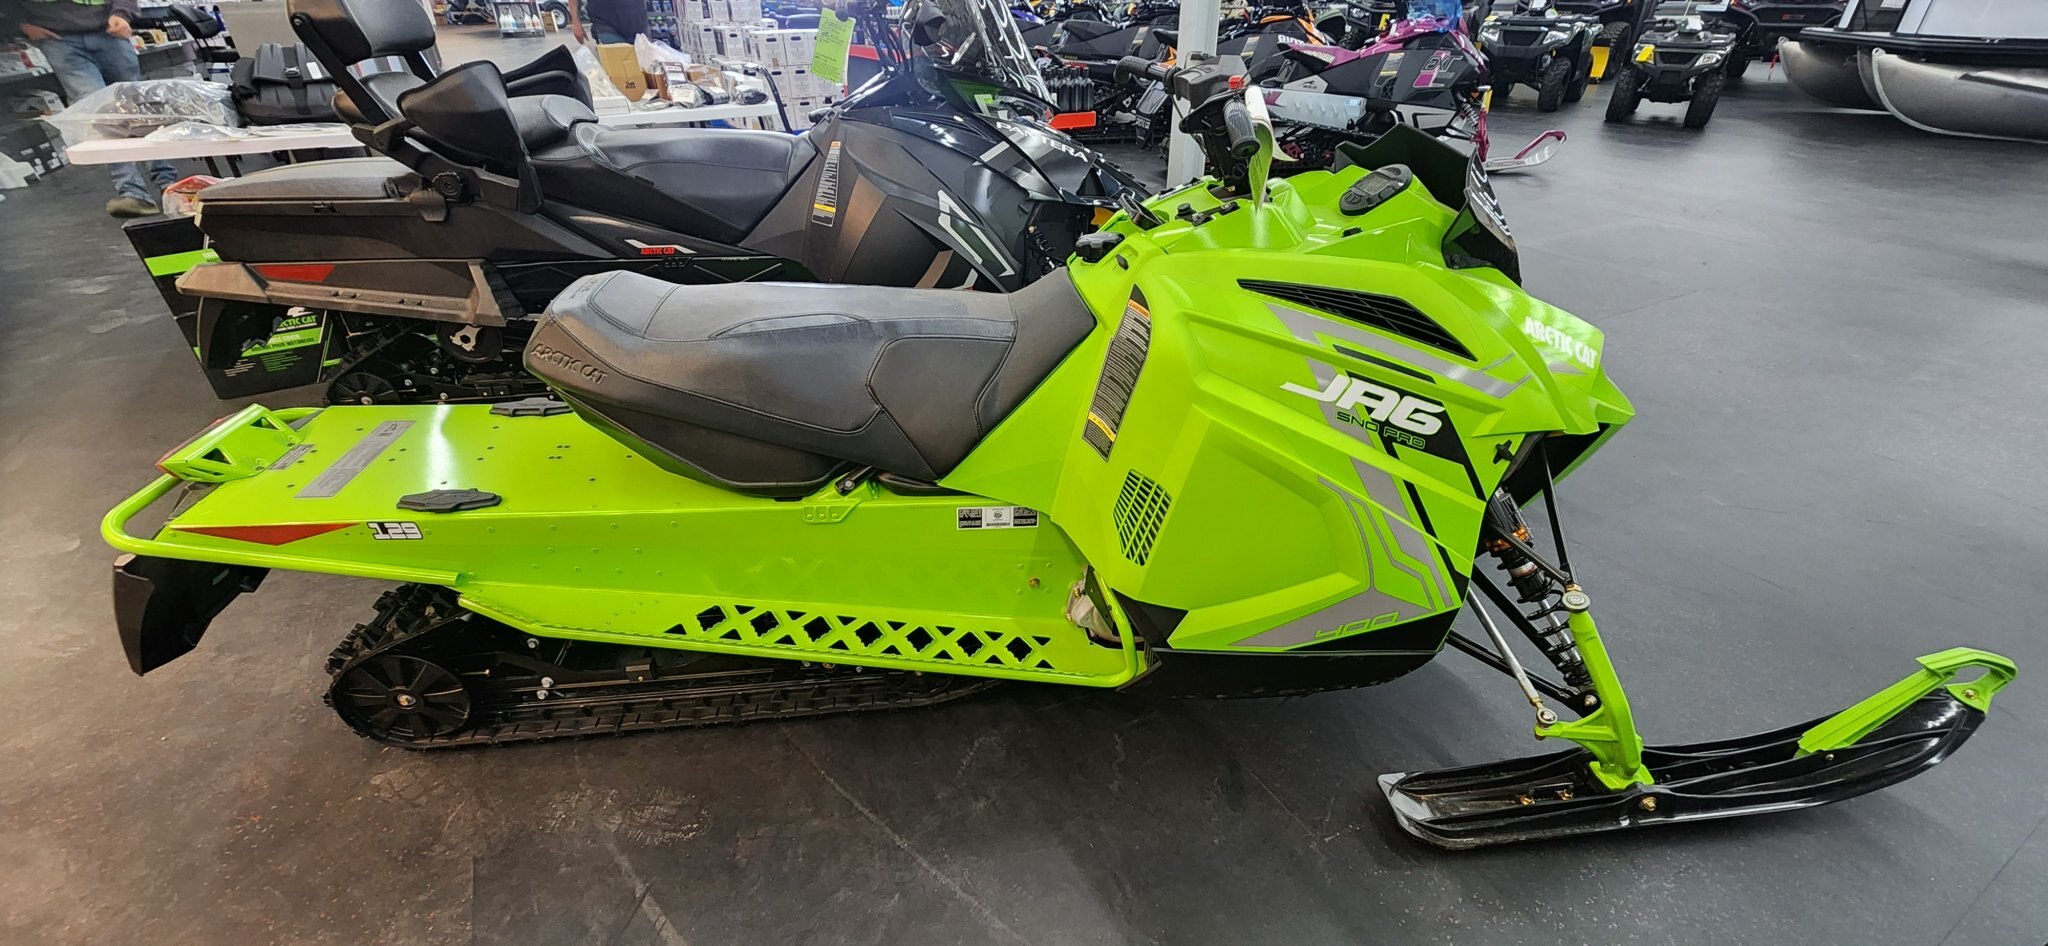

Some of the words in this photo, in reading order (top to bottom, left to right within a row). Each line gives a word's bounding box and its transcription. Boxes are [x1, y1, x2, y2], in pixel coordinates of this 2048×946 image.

[996, 121, 1088, 163] PANTERA
[663, 247, 676, 255] CAT
[301, 315, 317, 325] CAT
[1524, 316, 1573, 357] ARCTIC
[1574, 341, 1597, 369] CAT
[530, 343, 581, 371] ARCTIC
[580, 364, 608, 384] CAT
[1279, 374, 1446, 436] JAG
[1336, 411, 1380, 433] SNO
[1383, 427, 1426, 449] PRO
[366, 521, 423, 540] 129
[1314, 611, 1399, 638] 400
